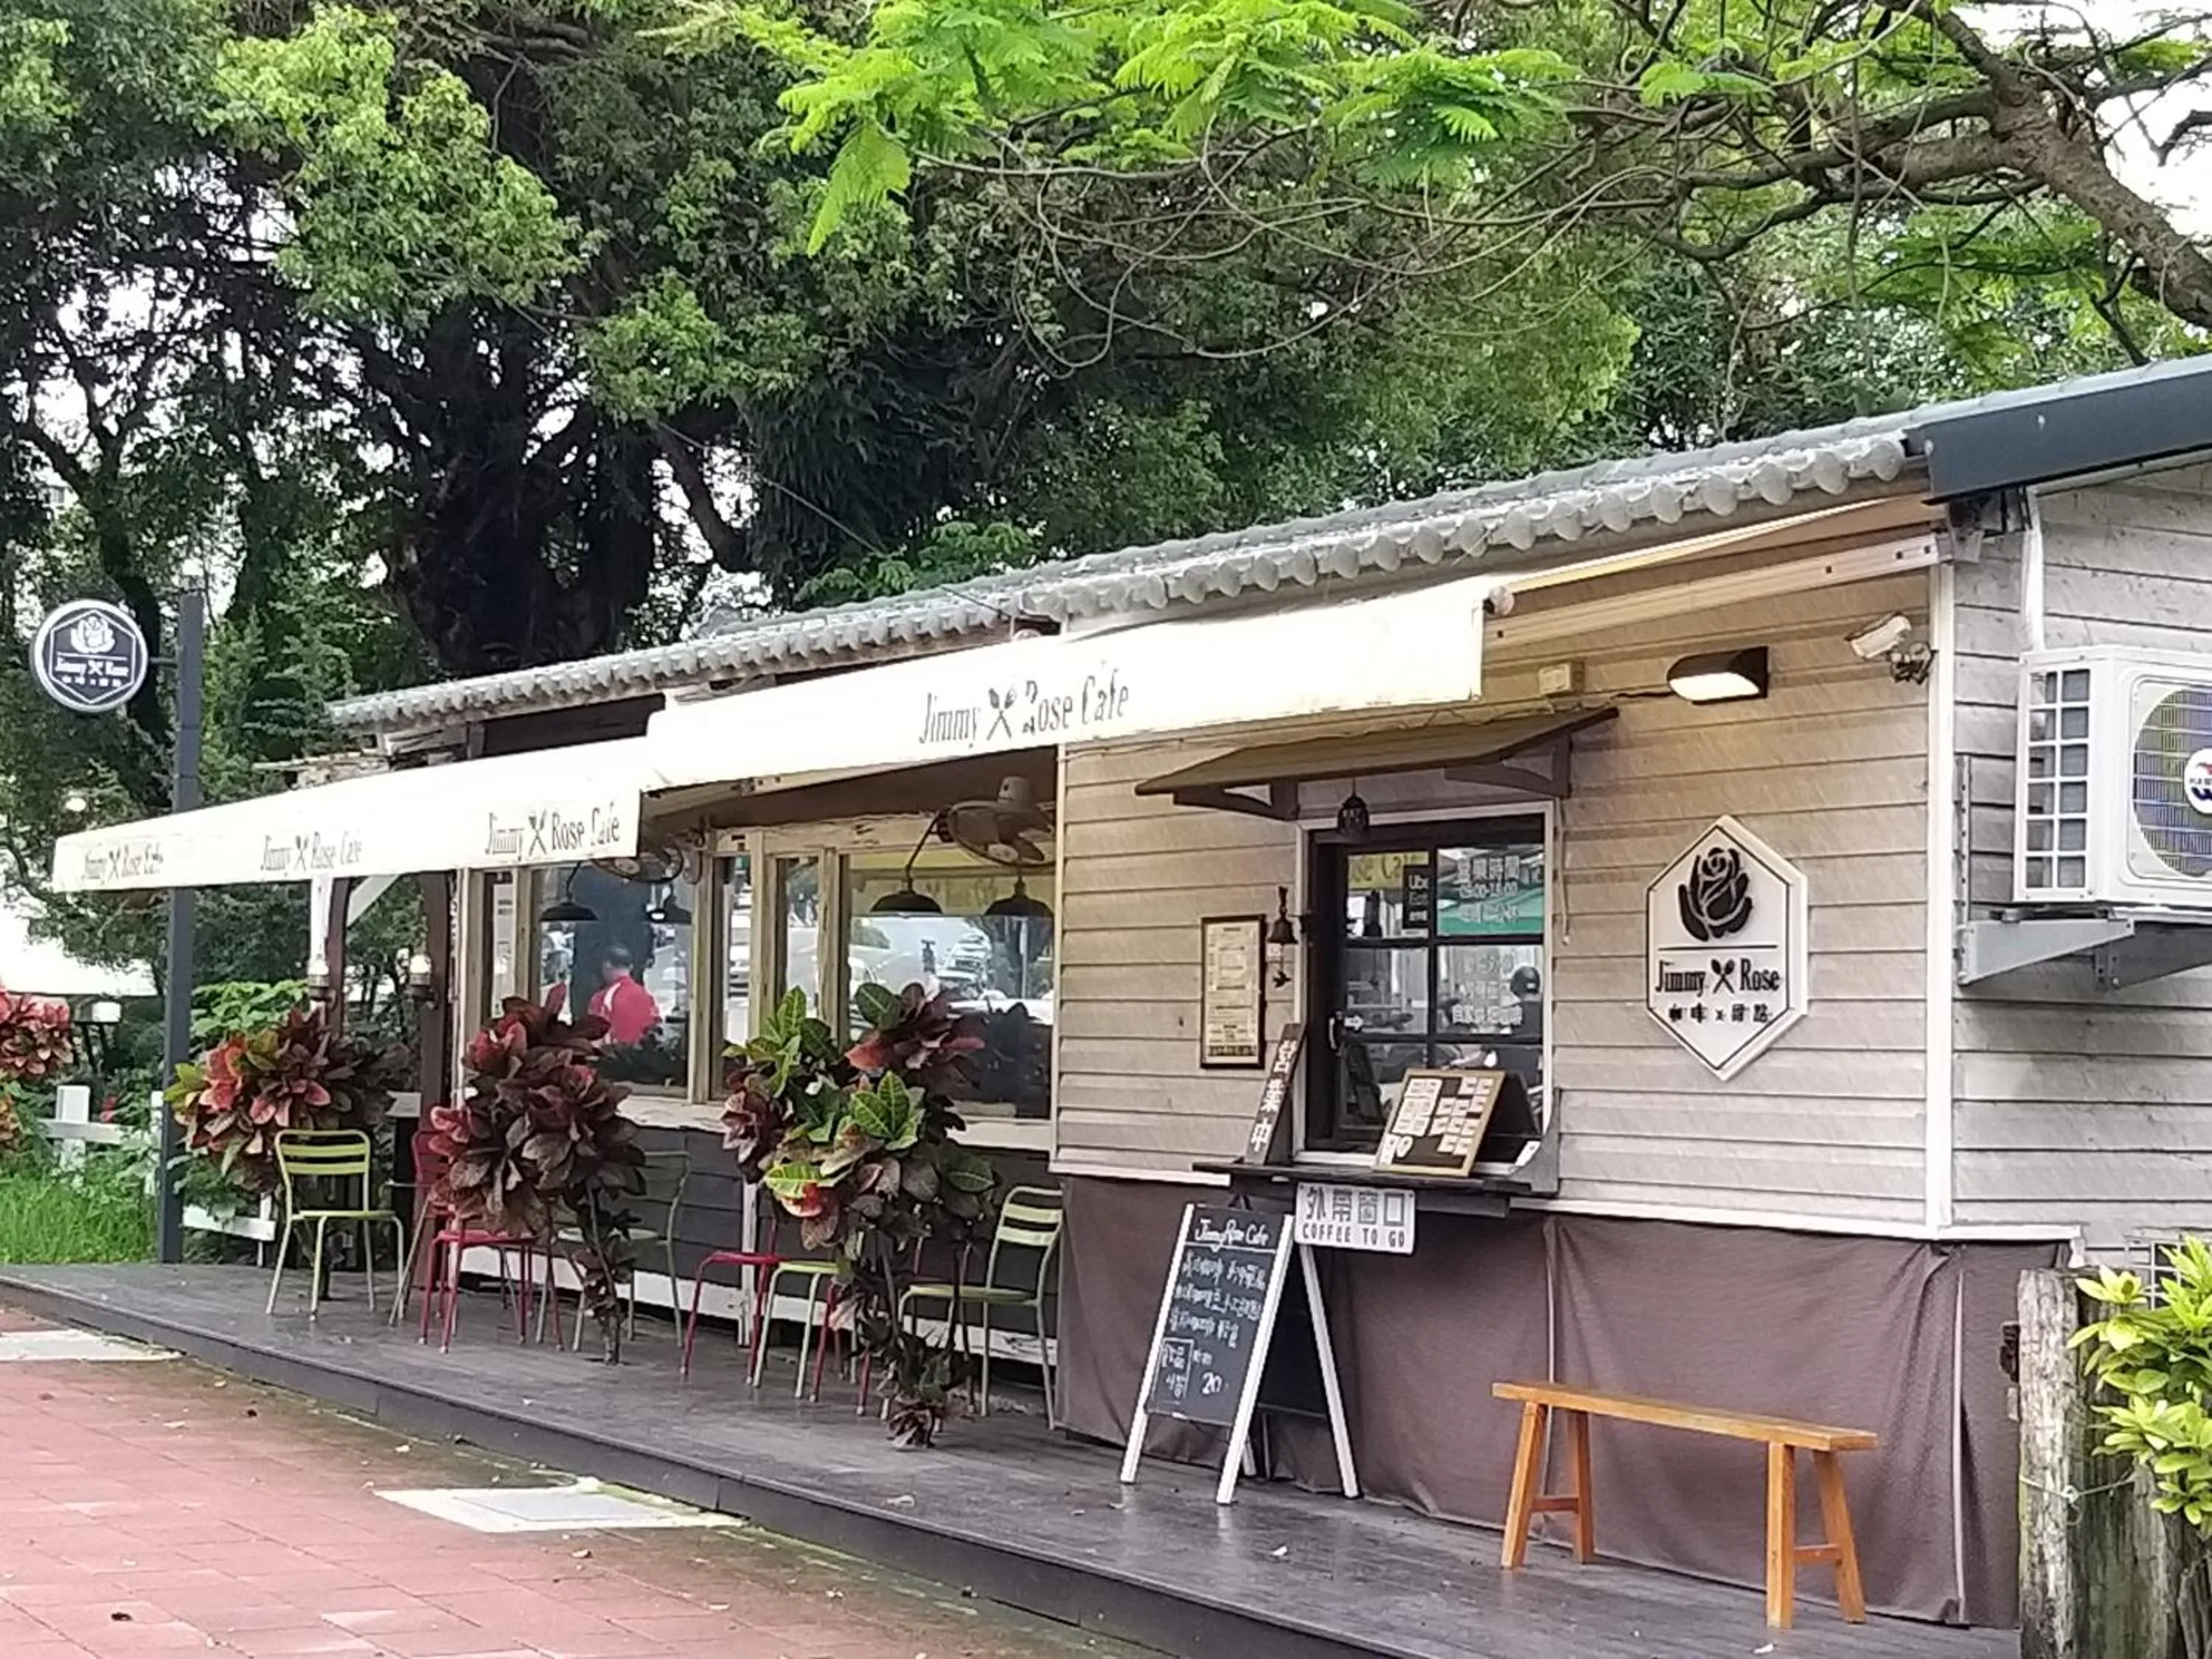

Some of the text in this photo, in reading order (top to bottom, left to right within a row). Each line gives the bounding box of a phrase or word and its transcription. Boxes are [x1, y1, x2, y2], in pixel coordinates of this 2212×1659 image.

[919, 692, 980, 748] Jimmy
[1023, 679, 1073, 736] Rose
[552, 811, 585, 849] Rose
[1655, 957, 1781, 997] Jimmy Rose
[1306, 1186, 1405, 1227] 外帶窗口
[1302, 1222, 1405, 1248] COFFEE TO GO
